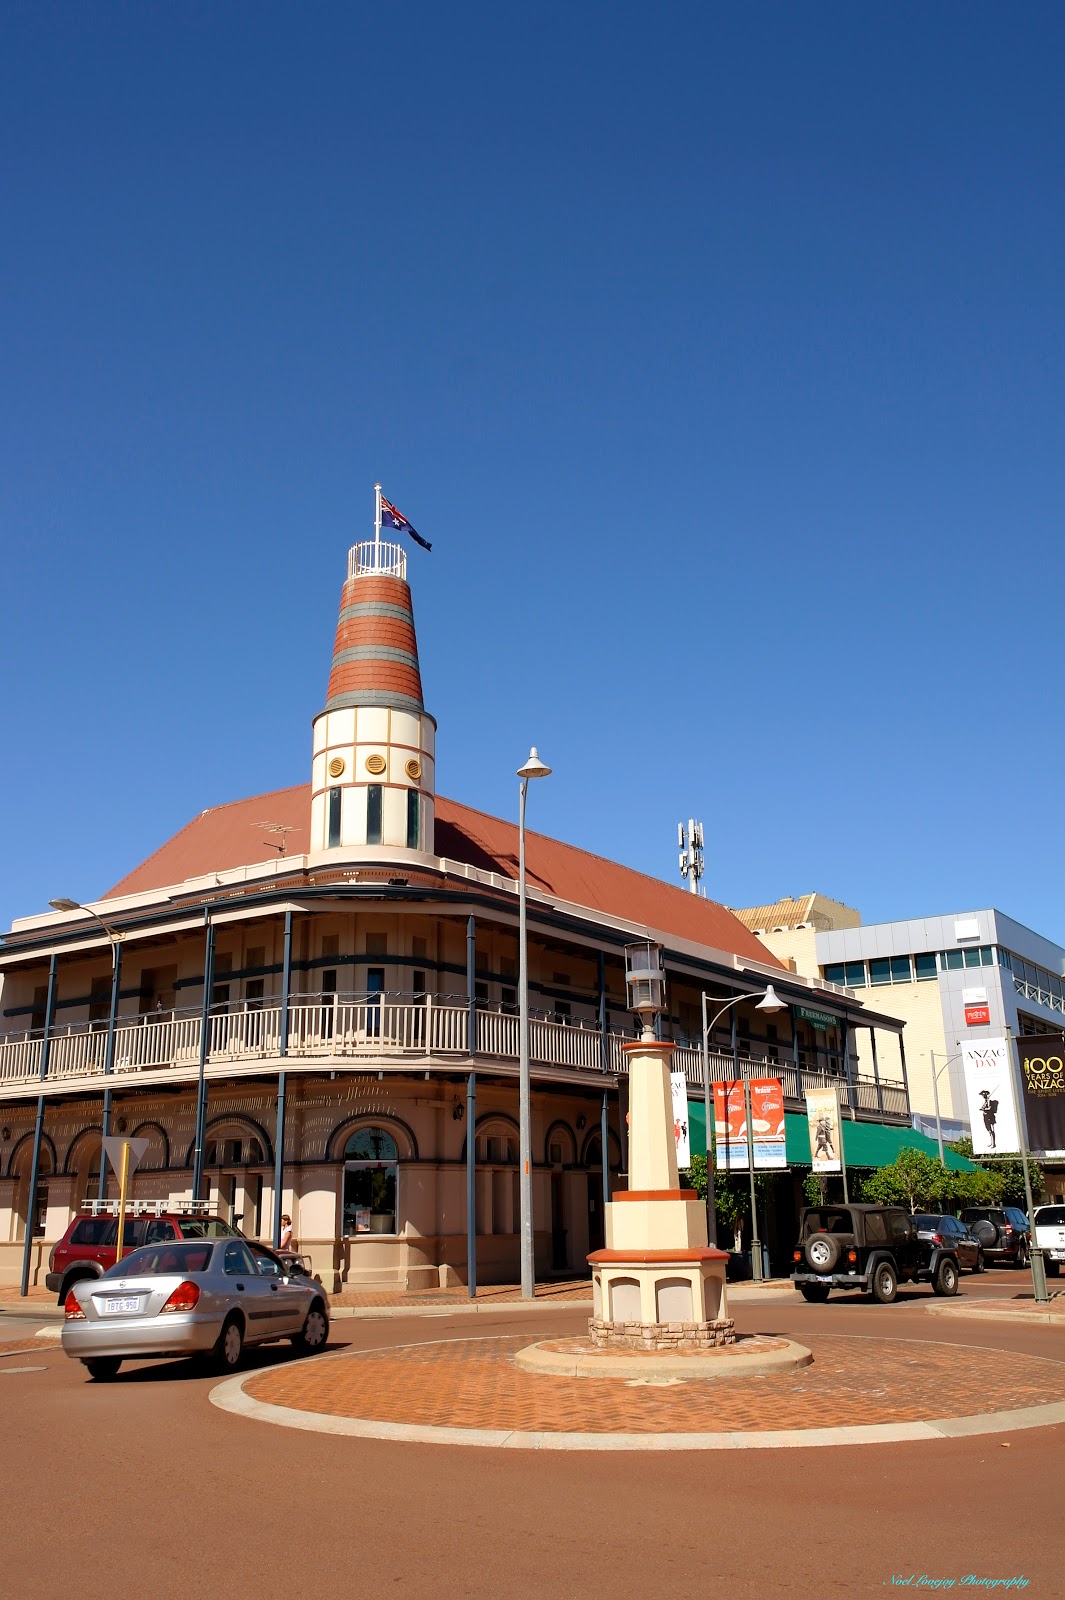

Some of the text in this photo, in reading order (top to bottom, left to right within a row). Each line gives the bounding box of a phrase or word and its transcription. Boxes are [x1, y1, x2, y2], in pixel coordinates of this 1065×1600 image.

[800, 1007, 837, 1024] FREEMASONS
[966, 1048, 1006, 1060] ANZAC
[975, 1058, 997, 1067] DAY
[1024, 1056, 1063, 1074] 100
[1026, 1072, 1051, 1081] YEARS
[1027, 1078, 1065, 1090] ANZAC
